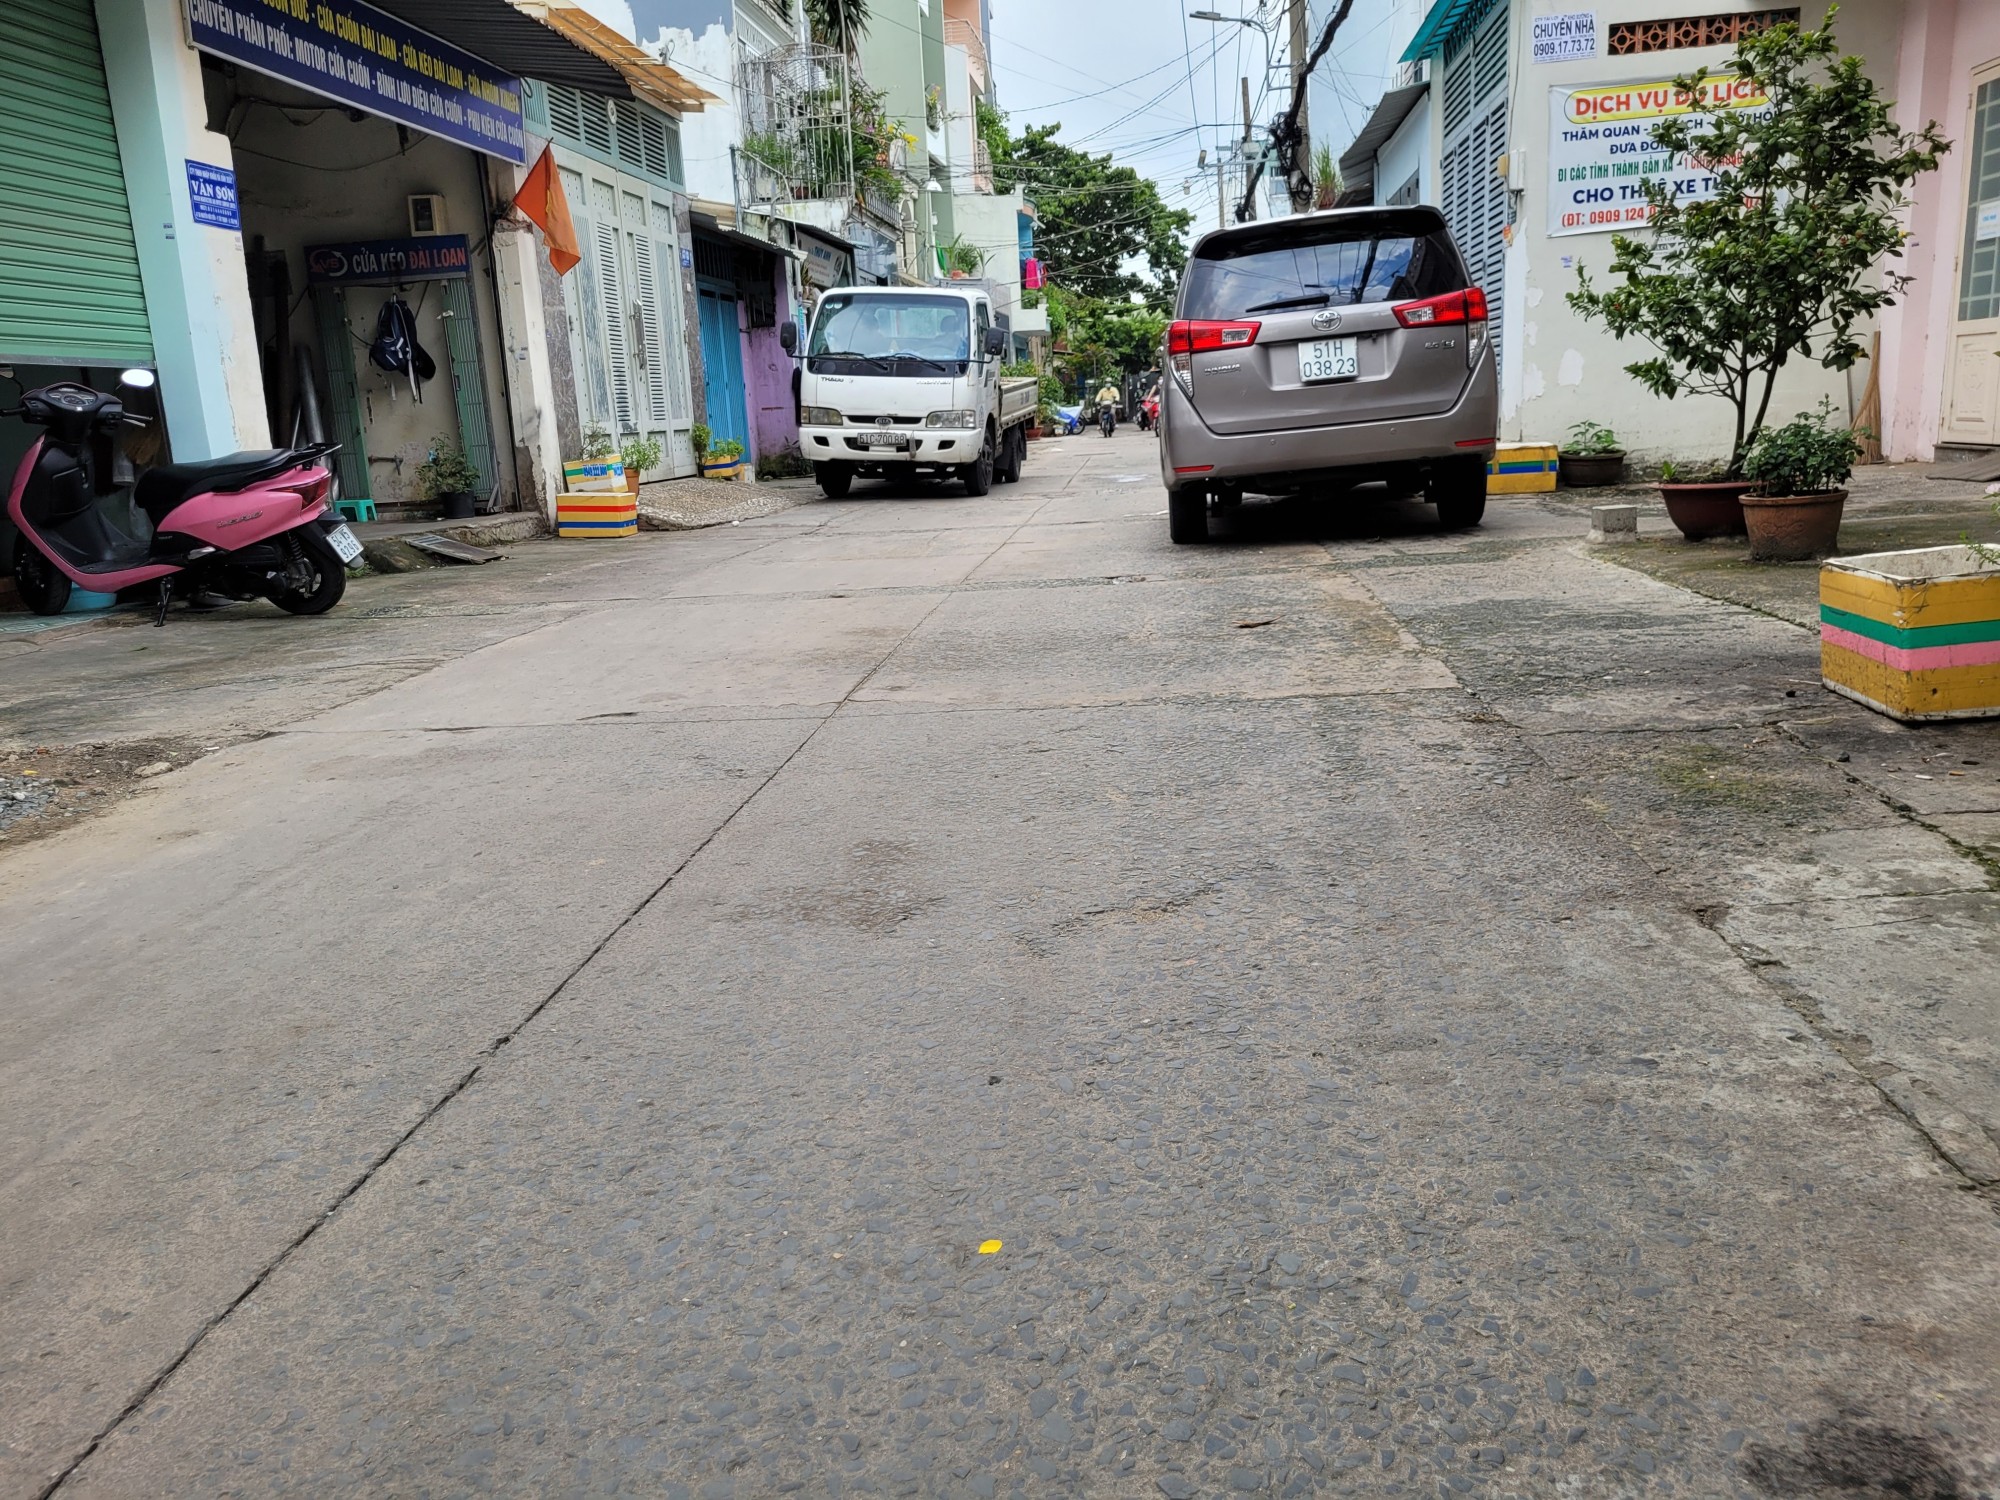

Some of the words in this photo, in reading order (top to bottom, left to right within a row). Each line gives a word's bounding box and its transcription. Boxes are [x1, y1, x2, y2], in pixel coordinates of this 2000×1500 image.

[1575, 14, 1594, 34] NHÀ
[317, 0, 335, 34] CỬA
[336, 10, 360, 45] CUỐN
[361, 22, 376, 52] ĐÀI
[377, 32, 397, 62] LOAN
[403, 38, 417, 71] CỬA
[419, 50, 433, 77] KÉO
[433, 56, 445, 82] ĐÀI
[446, 64, 463, 90] LOAN
[1534, 38, 1595, 56] 0909.17.73.72
[190, 0, 234, 36] CHUYÊN
[236, 13, 266, 48] PHÂN
[266, 22, 293, 60] PHỐI:
[295, 37, 327, 73] MOTOR
[328, 45, 346, 80] CỬA
[347, 56, 370, 90] CUỐN
[377, 68, 396, 100] BÌNH
[396, 79, 411, 106] LƯU
[412, 84, 429, 115] ĐIỆN
[429, 88, 444, 118] CỬA
[445, 96, 463, 126] CUỐN
[1576, 94, 1630, 120] DỊCH
[1637, 90, 1668, 113] VỤ
[1562, 127, 1599, 142] THĂM
[1602, 124, 1640, 138] QUAN
[1610, 142, 1636, 154] ĐƯA
[1558, 168, 1566, 182] ĐI
[1570, 164, 1586, 181] CÁC
[1590, 161, 1608, 179] TỈNH
[1612, 160, 1639, 177] THÀNH
[1642, 155, 1659, 174] GẦN
[1662, 158, 1673, 172] XA
[191, 178, 214, 197] VĂN
[216, 186, 235, 202] SƠN
[1573, 187, 1614, 204] CHO
[1672, 179, 1696, 194] XE
[1562, 213, 1585, 228] (ĐT:
[1590, 210, 1620, 224] 0909
[1625, 207, 1644, 220] 124
[352, 248, 378, 274] CỬA
[381, 247, 406, 272] KÉO
[410, 246, 430, 269] ĐÀI
[434, 247, 466, 268] LOAN
[1314, 340, 1343, 358] 51H
[1304, 358, 1356, 377] 038.23
[340, 540, 360, 559] 9296
